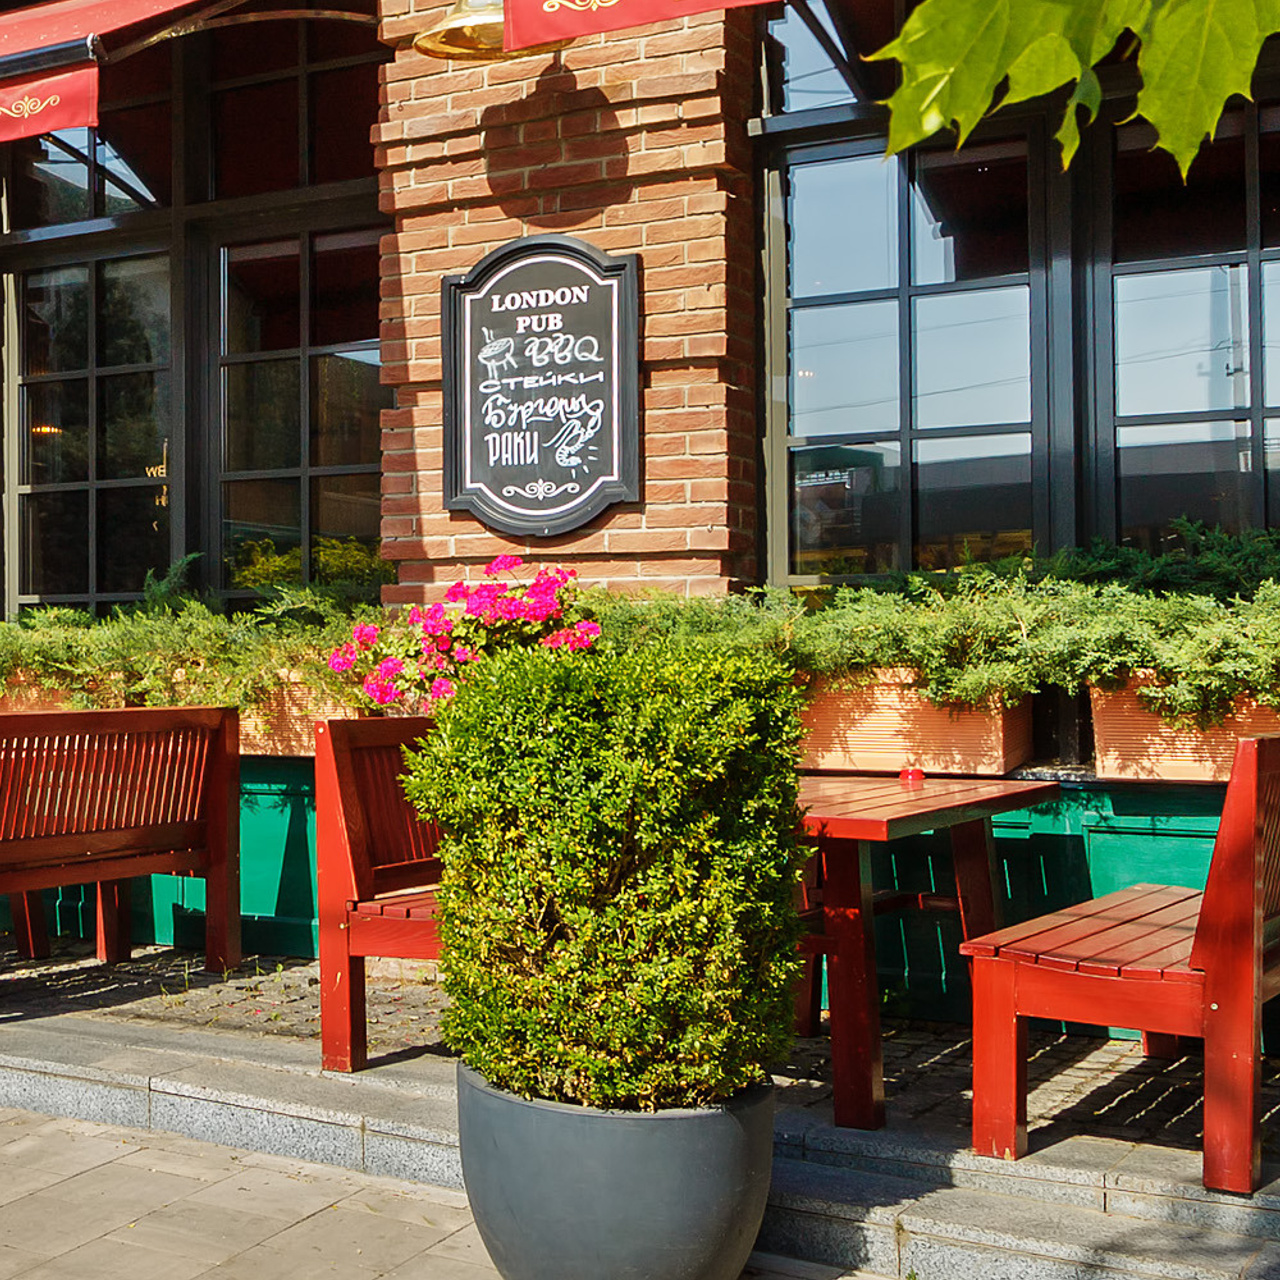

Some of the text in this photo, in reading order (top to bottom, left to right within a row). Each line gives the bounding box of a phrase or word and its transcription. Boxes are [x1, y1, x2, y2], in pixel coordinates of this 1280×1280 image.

[491, 285, 590, 312] LONDON
[516, 313, 563, 334] PUB
[524, 332, 604, 367] BBQ
[478, 371, 604, 393] СТЕЙКИ
[484, 431, 539, 467] РАКИ
